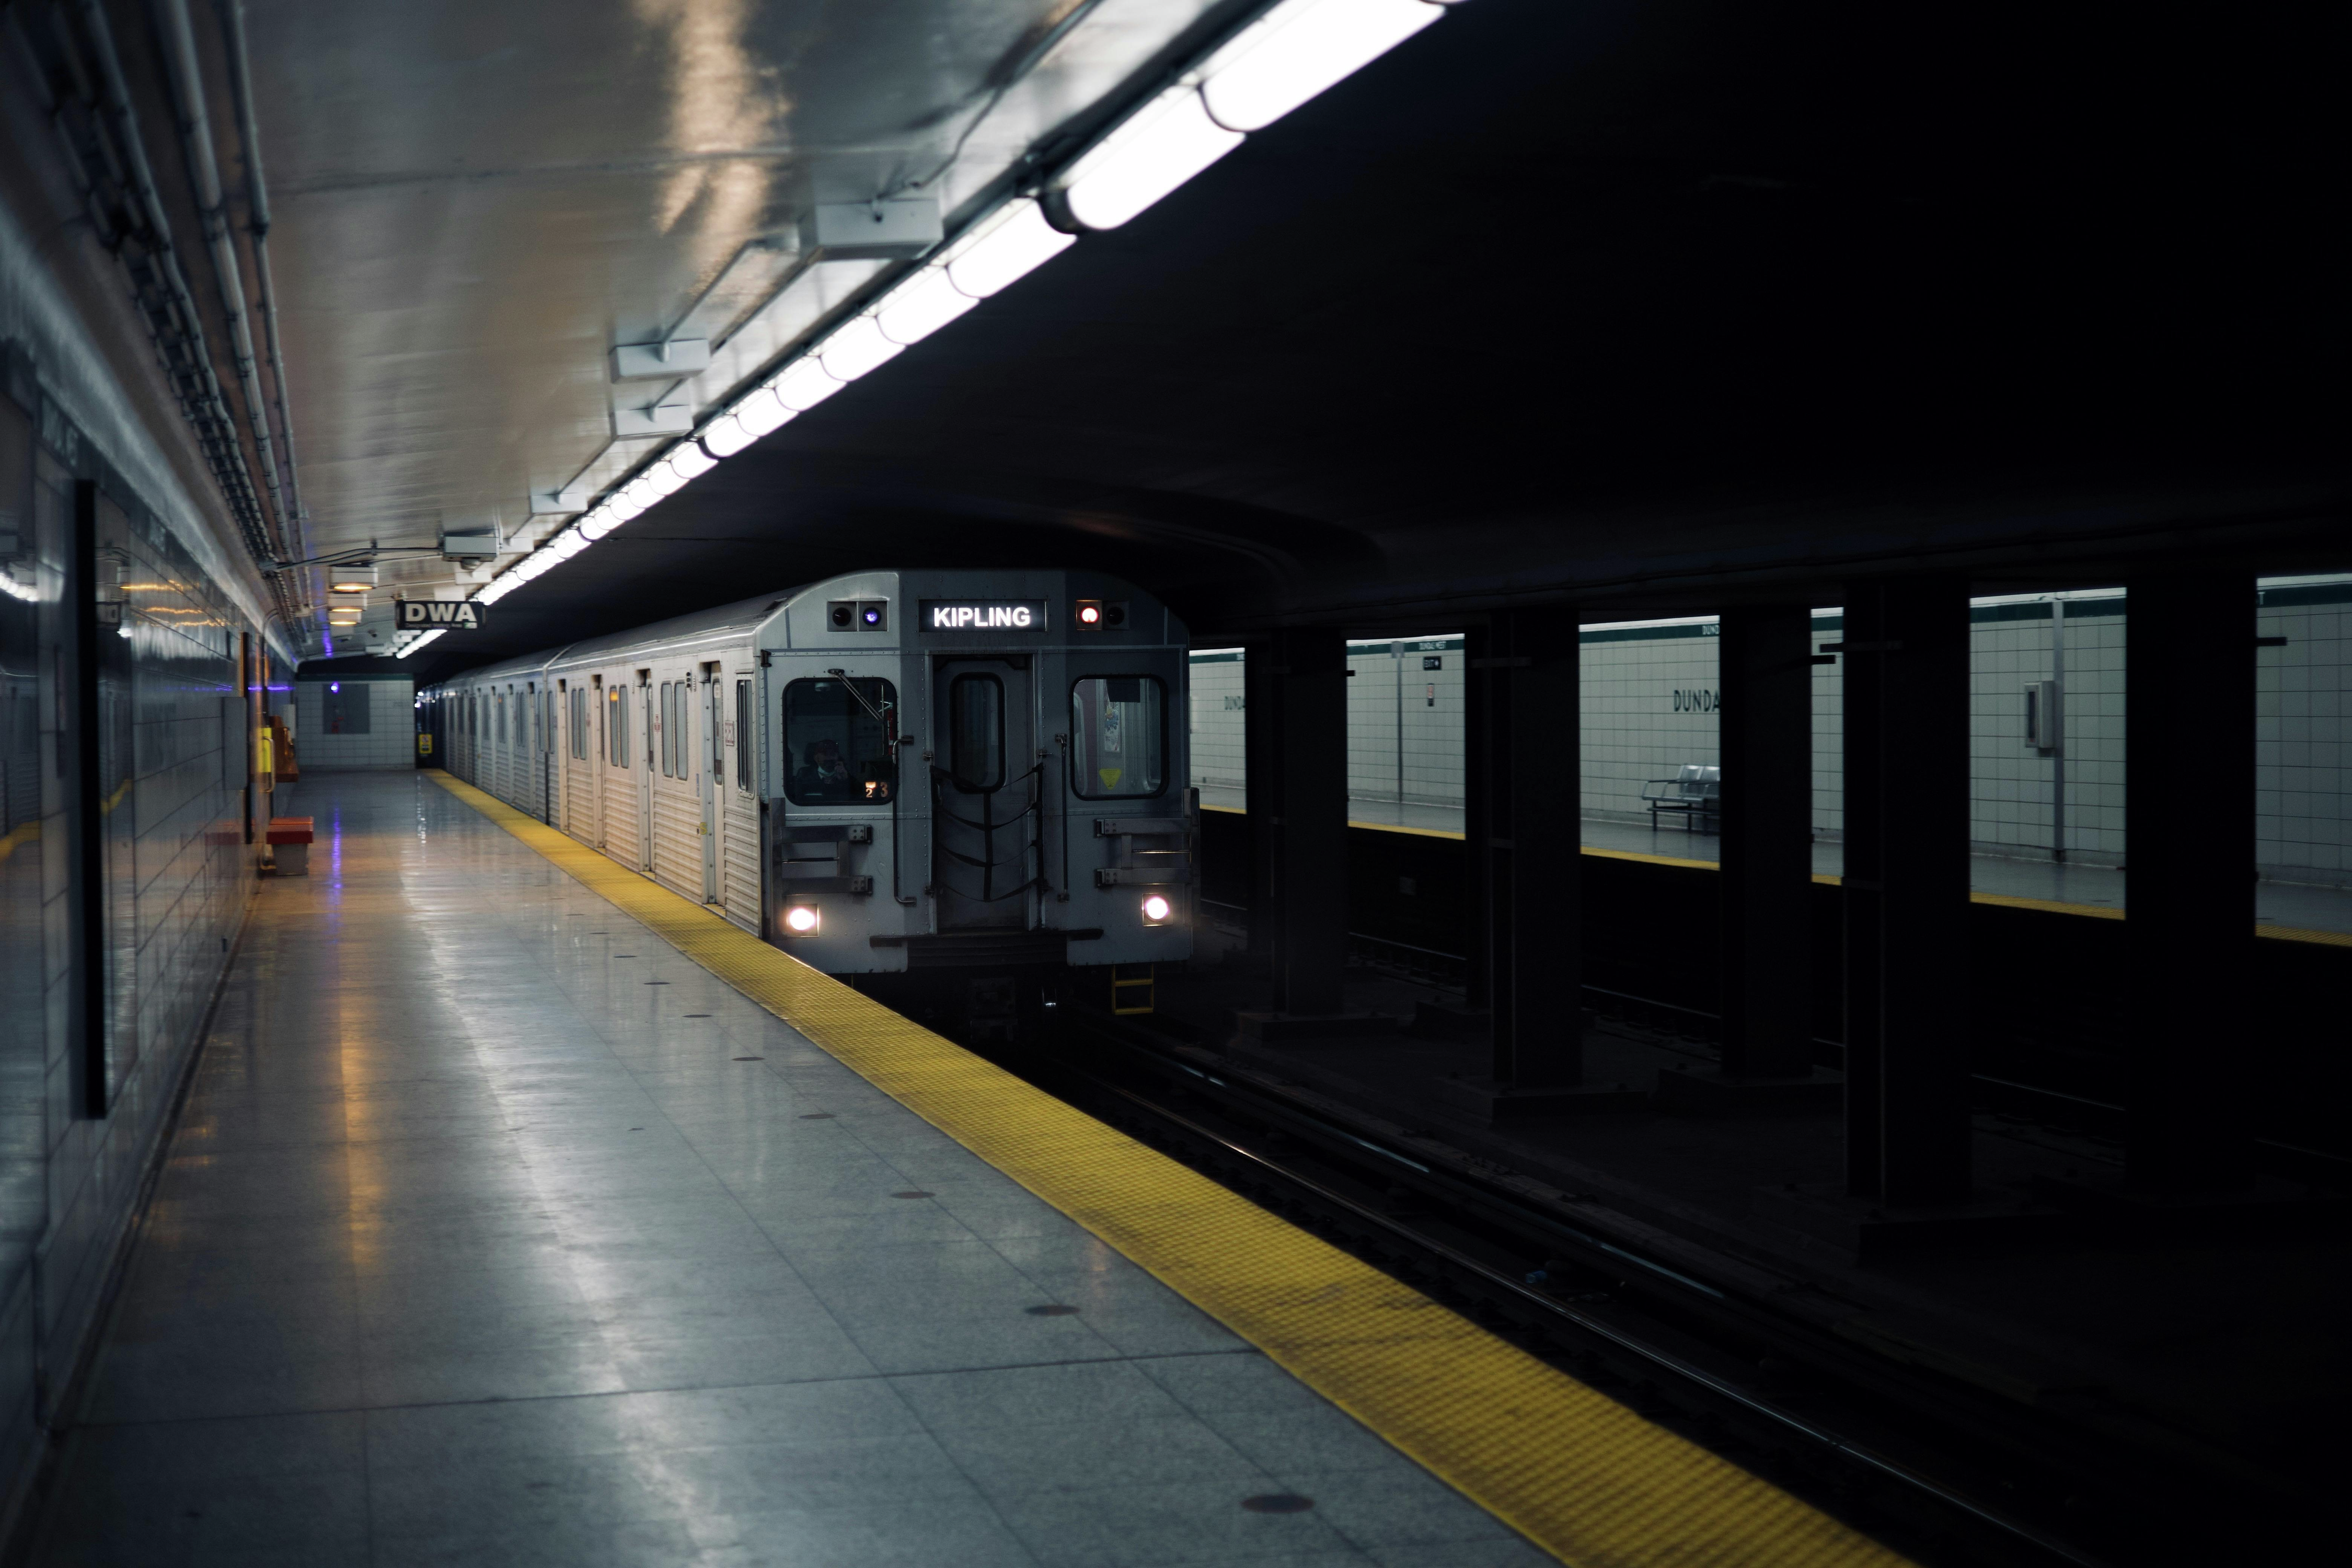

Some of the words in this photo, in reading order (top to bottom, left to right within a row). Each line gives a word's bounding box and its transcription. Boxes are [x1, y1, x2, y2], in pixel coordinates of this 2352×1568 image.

[405, 603, 477, 622] DWA
[934, 607, 1030, 627] KIPLING
[866, 788, 873, 798] 2
[880, 782, 888, 797] 3
